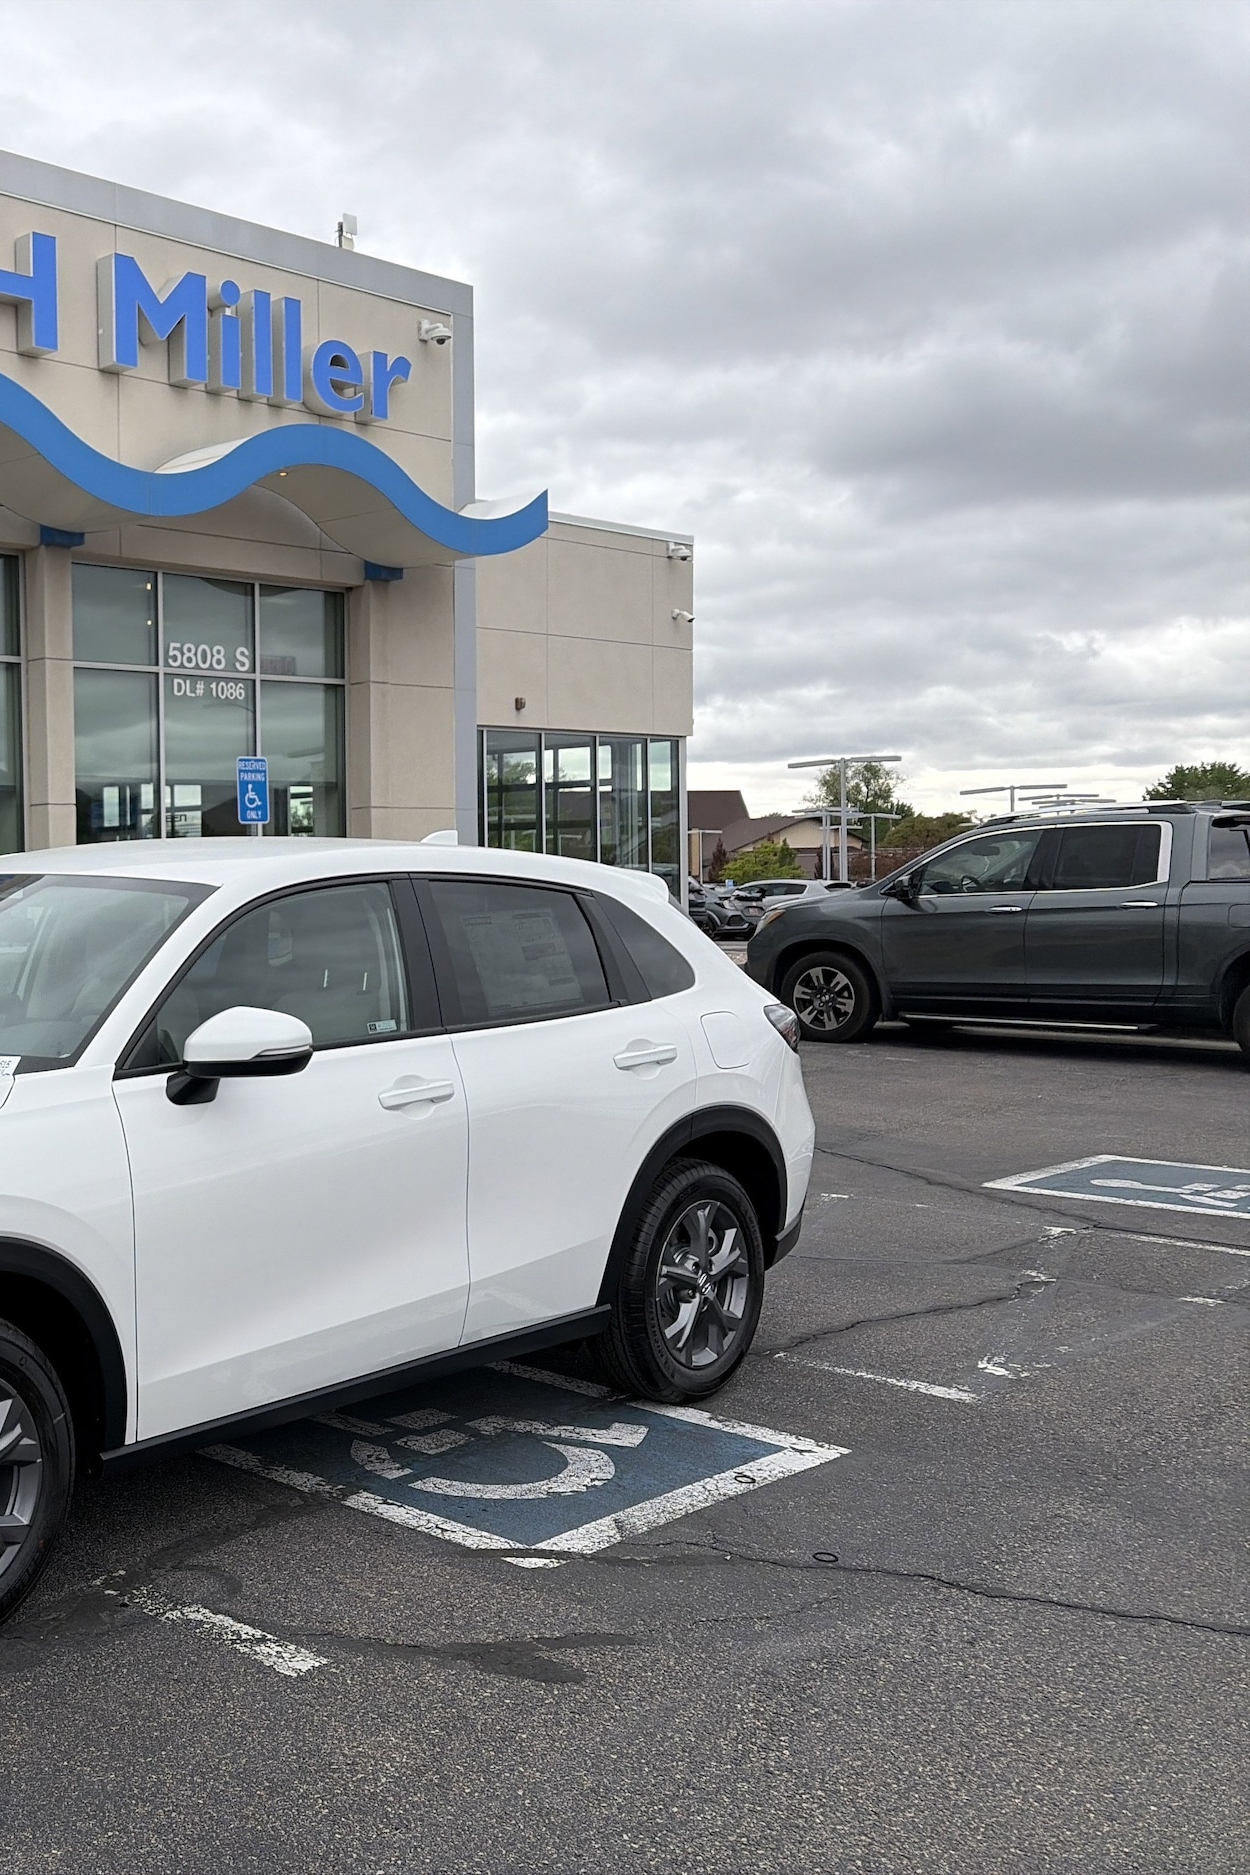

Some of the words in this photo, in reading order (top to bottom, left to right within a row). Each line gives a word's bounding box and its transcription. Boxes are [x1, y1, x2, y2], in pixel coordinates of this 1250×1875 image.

[97, 253, 411, 424] Miller
[168, 642, 226, 670] 5808
[235, 646, 250, 671] S
[173, 678, 205, 697] DL#
[210, 681, 245, 700] 1086
[238, 760, 266, 771] RESERVED
[240, 772, 265, 782] PARKING
[246, 810, 262, 819] ONLY
